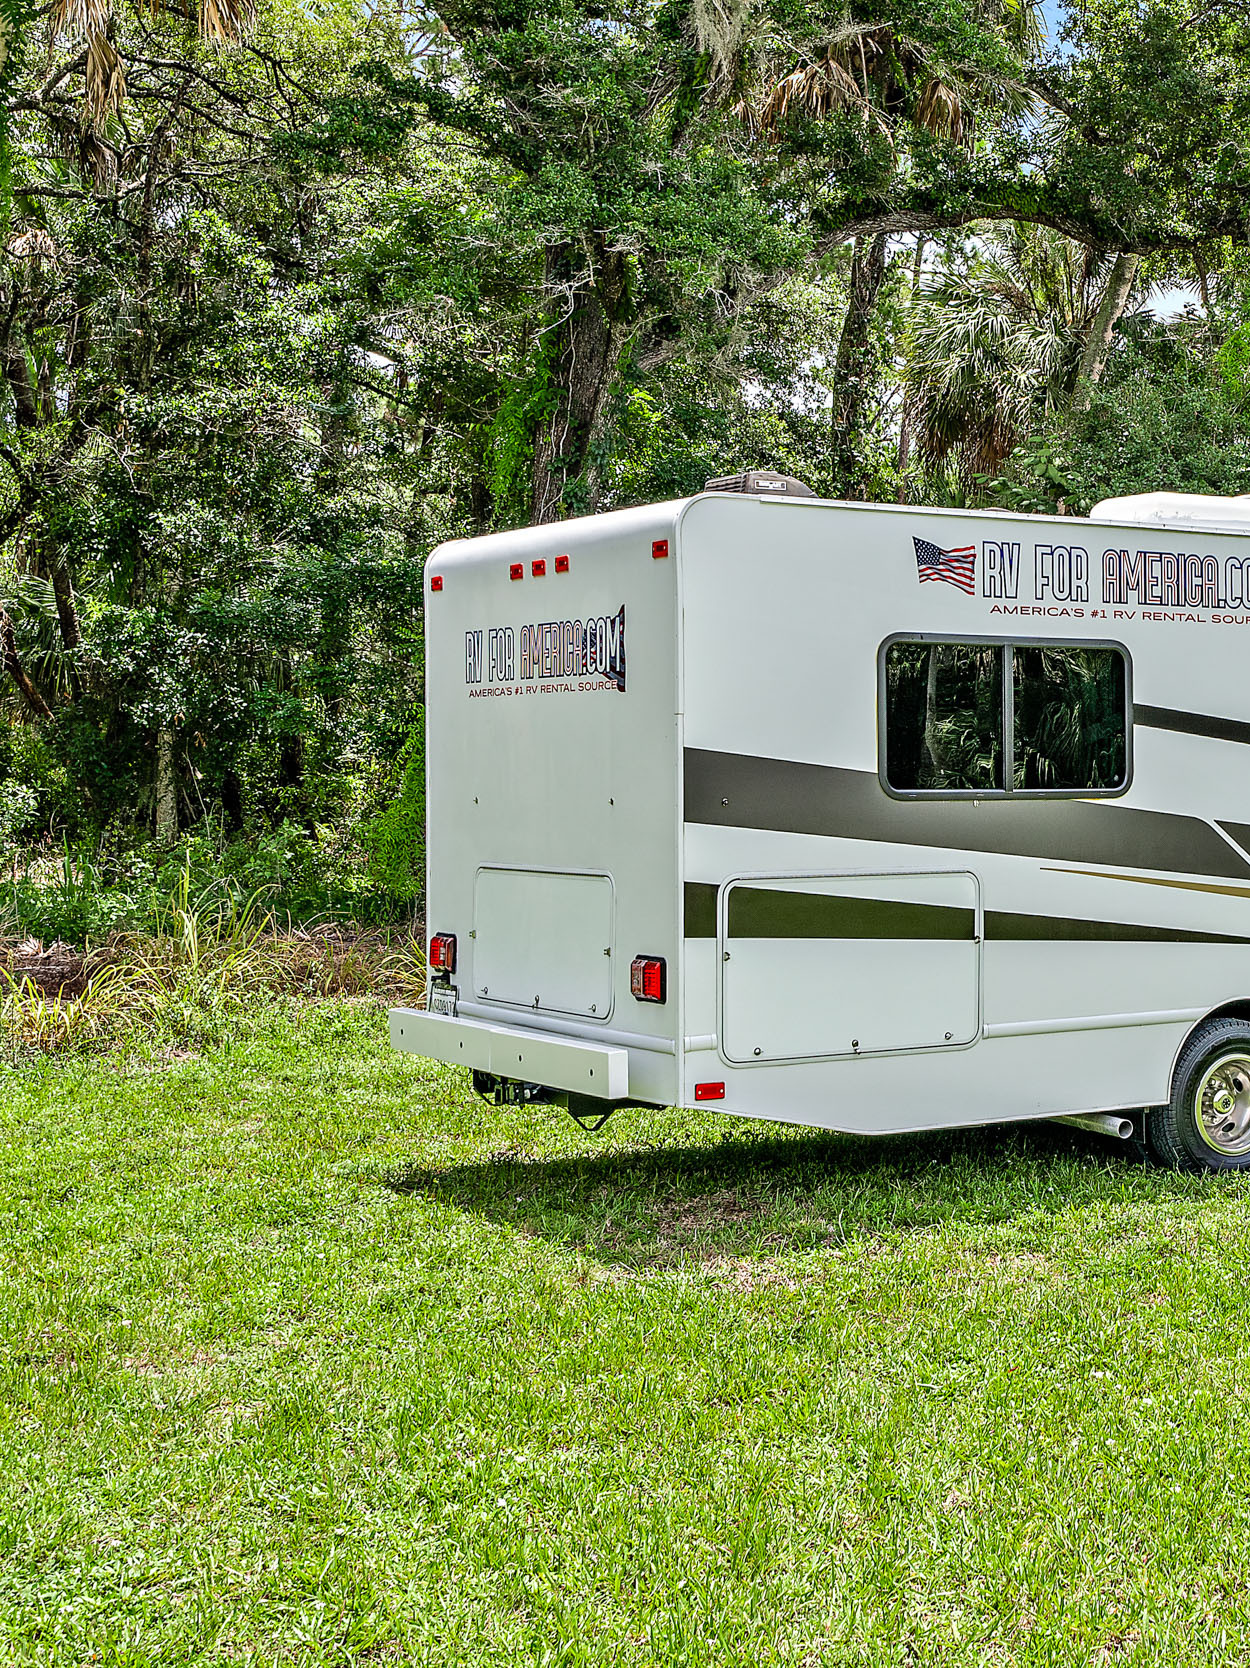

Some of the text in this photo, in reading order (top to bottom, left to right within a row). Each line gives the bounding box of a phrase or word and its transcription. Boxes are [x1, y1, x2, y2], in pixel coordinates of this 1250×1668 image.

[983, 541, 1020, 599] RV
[1035, 544, 1089, 602] FOR
[990, 604, 1085, 618] AMERICA'S
[1090, 609, 1108, 619] #1
[1113, 610, 1136, 620] RV
[1142, 611, 1206, 623] RENTAL
[466, 615, 621, 684] RV FOR AMERICA.COM
[469, 680, 618, 698] AMERICA'S #1 RV RENTAL SOURCE
